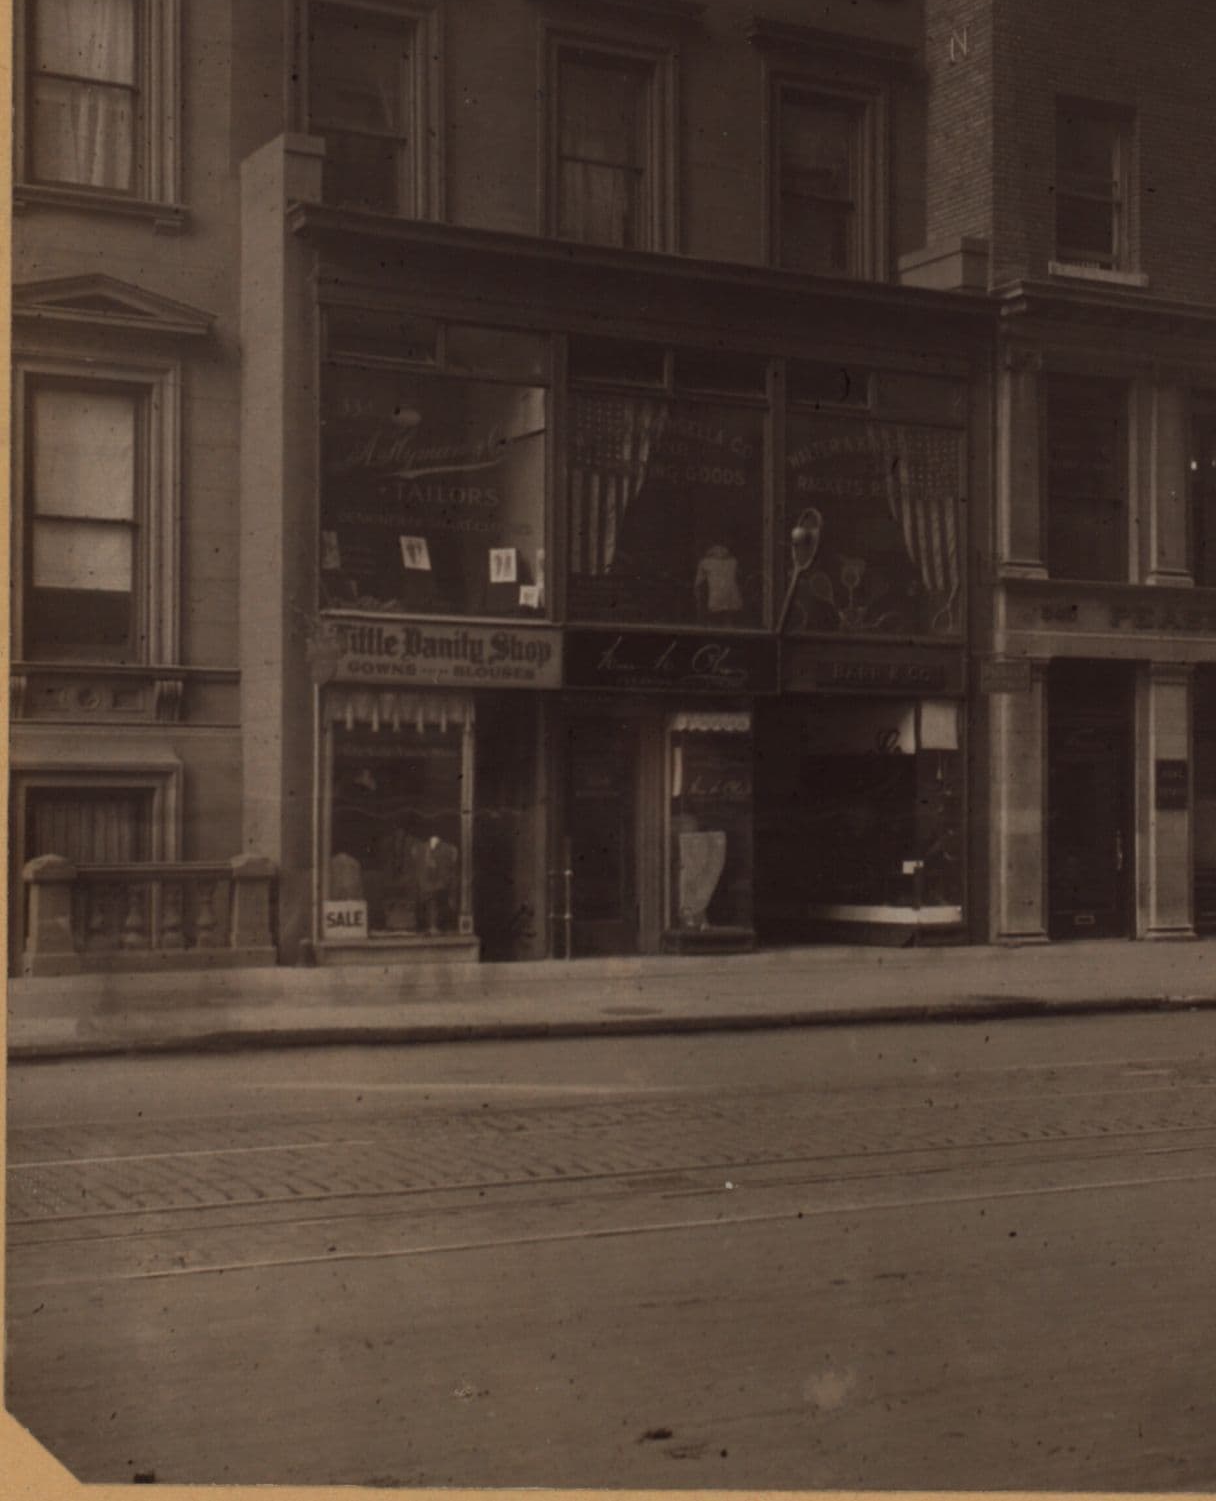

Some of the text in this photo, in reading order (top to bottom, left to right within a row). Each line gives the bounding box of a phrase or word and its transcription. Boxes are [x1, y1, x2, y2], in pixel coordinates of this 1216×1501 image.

[396, 483, 499, 508] TAILORS
[402, 626, 484, 664] Vanity
[488, 631, 552, 668] Shop
[347, 660, 536, 681] GOWNS BLOUSES
[326, 911, 363, 928] SALE
